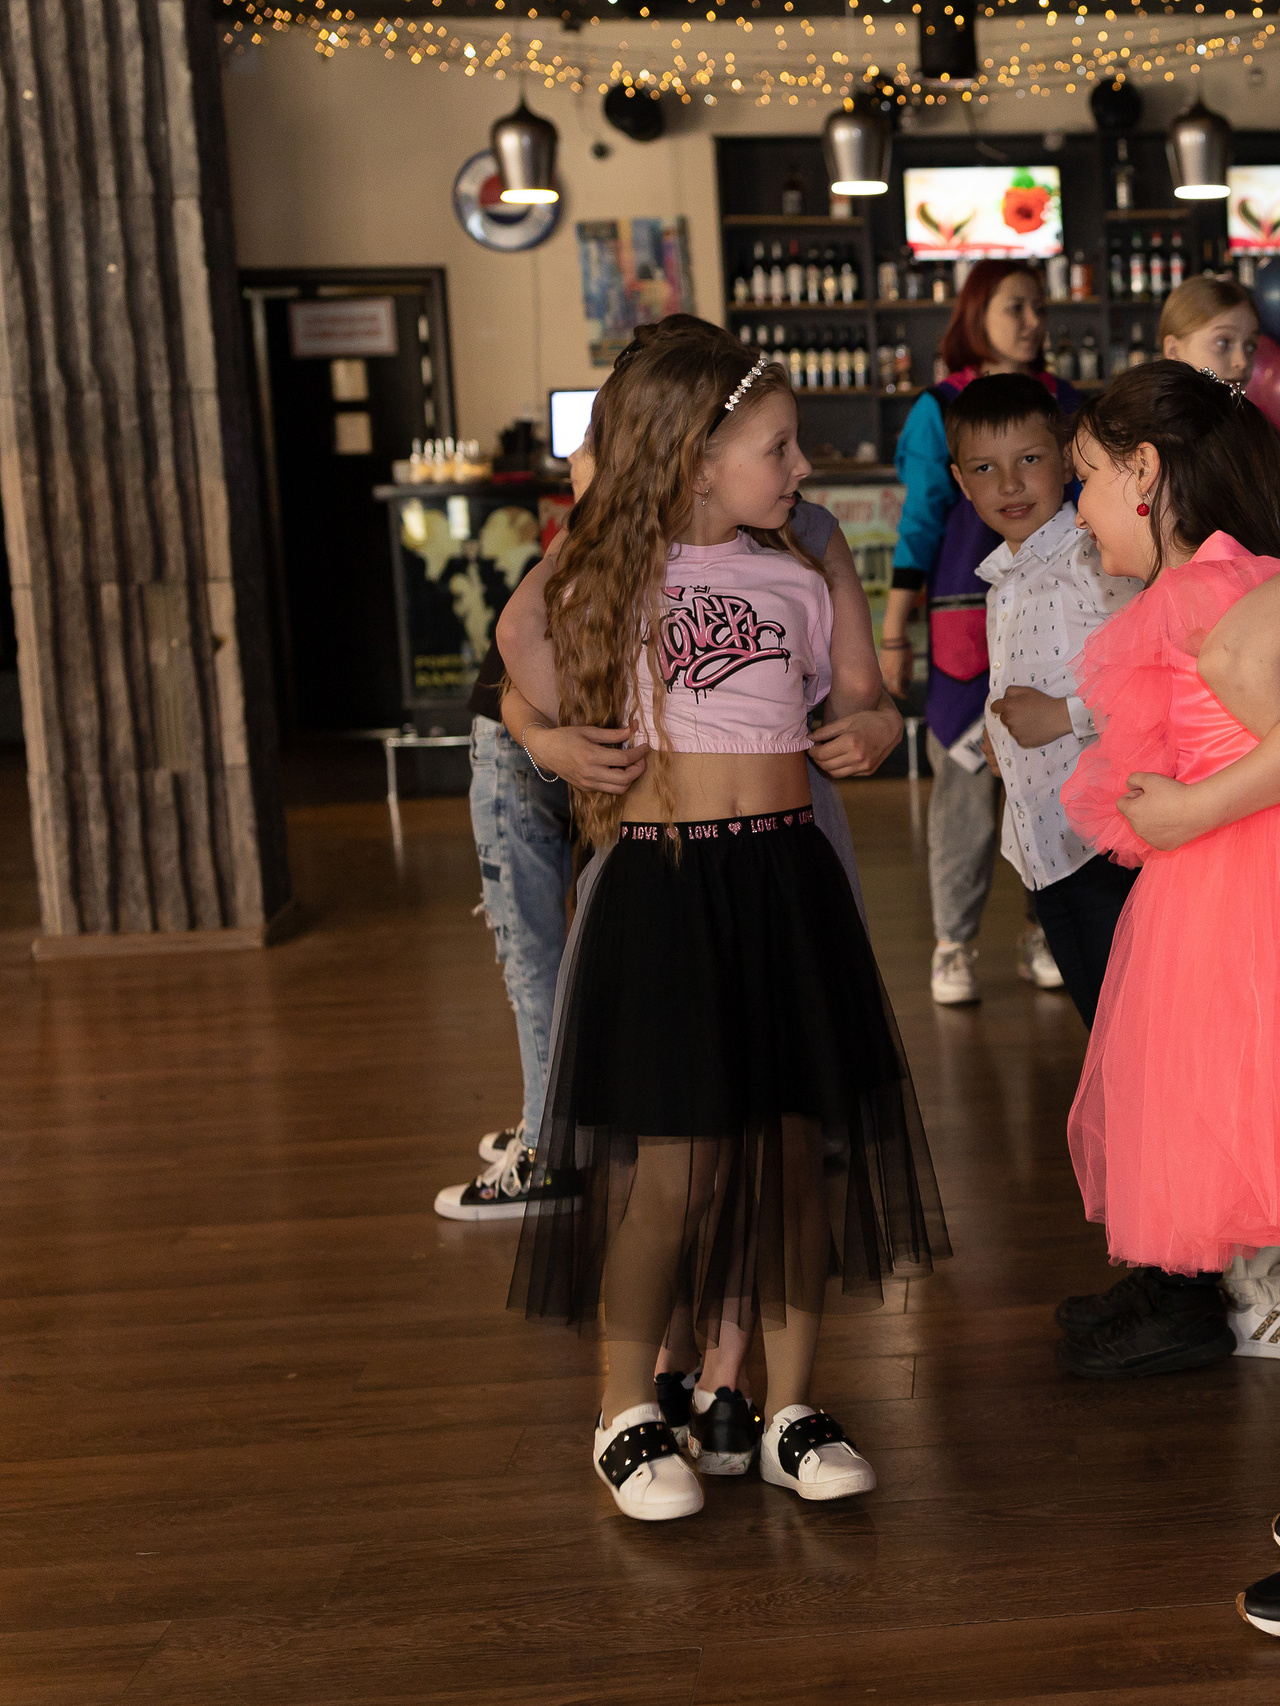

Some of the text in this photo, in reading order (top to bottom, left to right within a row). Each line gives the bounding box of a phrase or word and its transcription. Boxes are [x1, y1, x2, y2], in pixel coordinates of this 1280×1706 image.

[632, 826, 658, 841] LOVE
[688, 824, 719, 840] LOVE
[750, 817, 778, 833] LOVE
